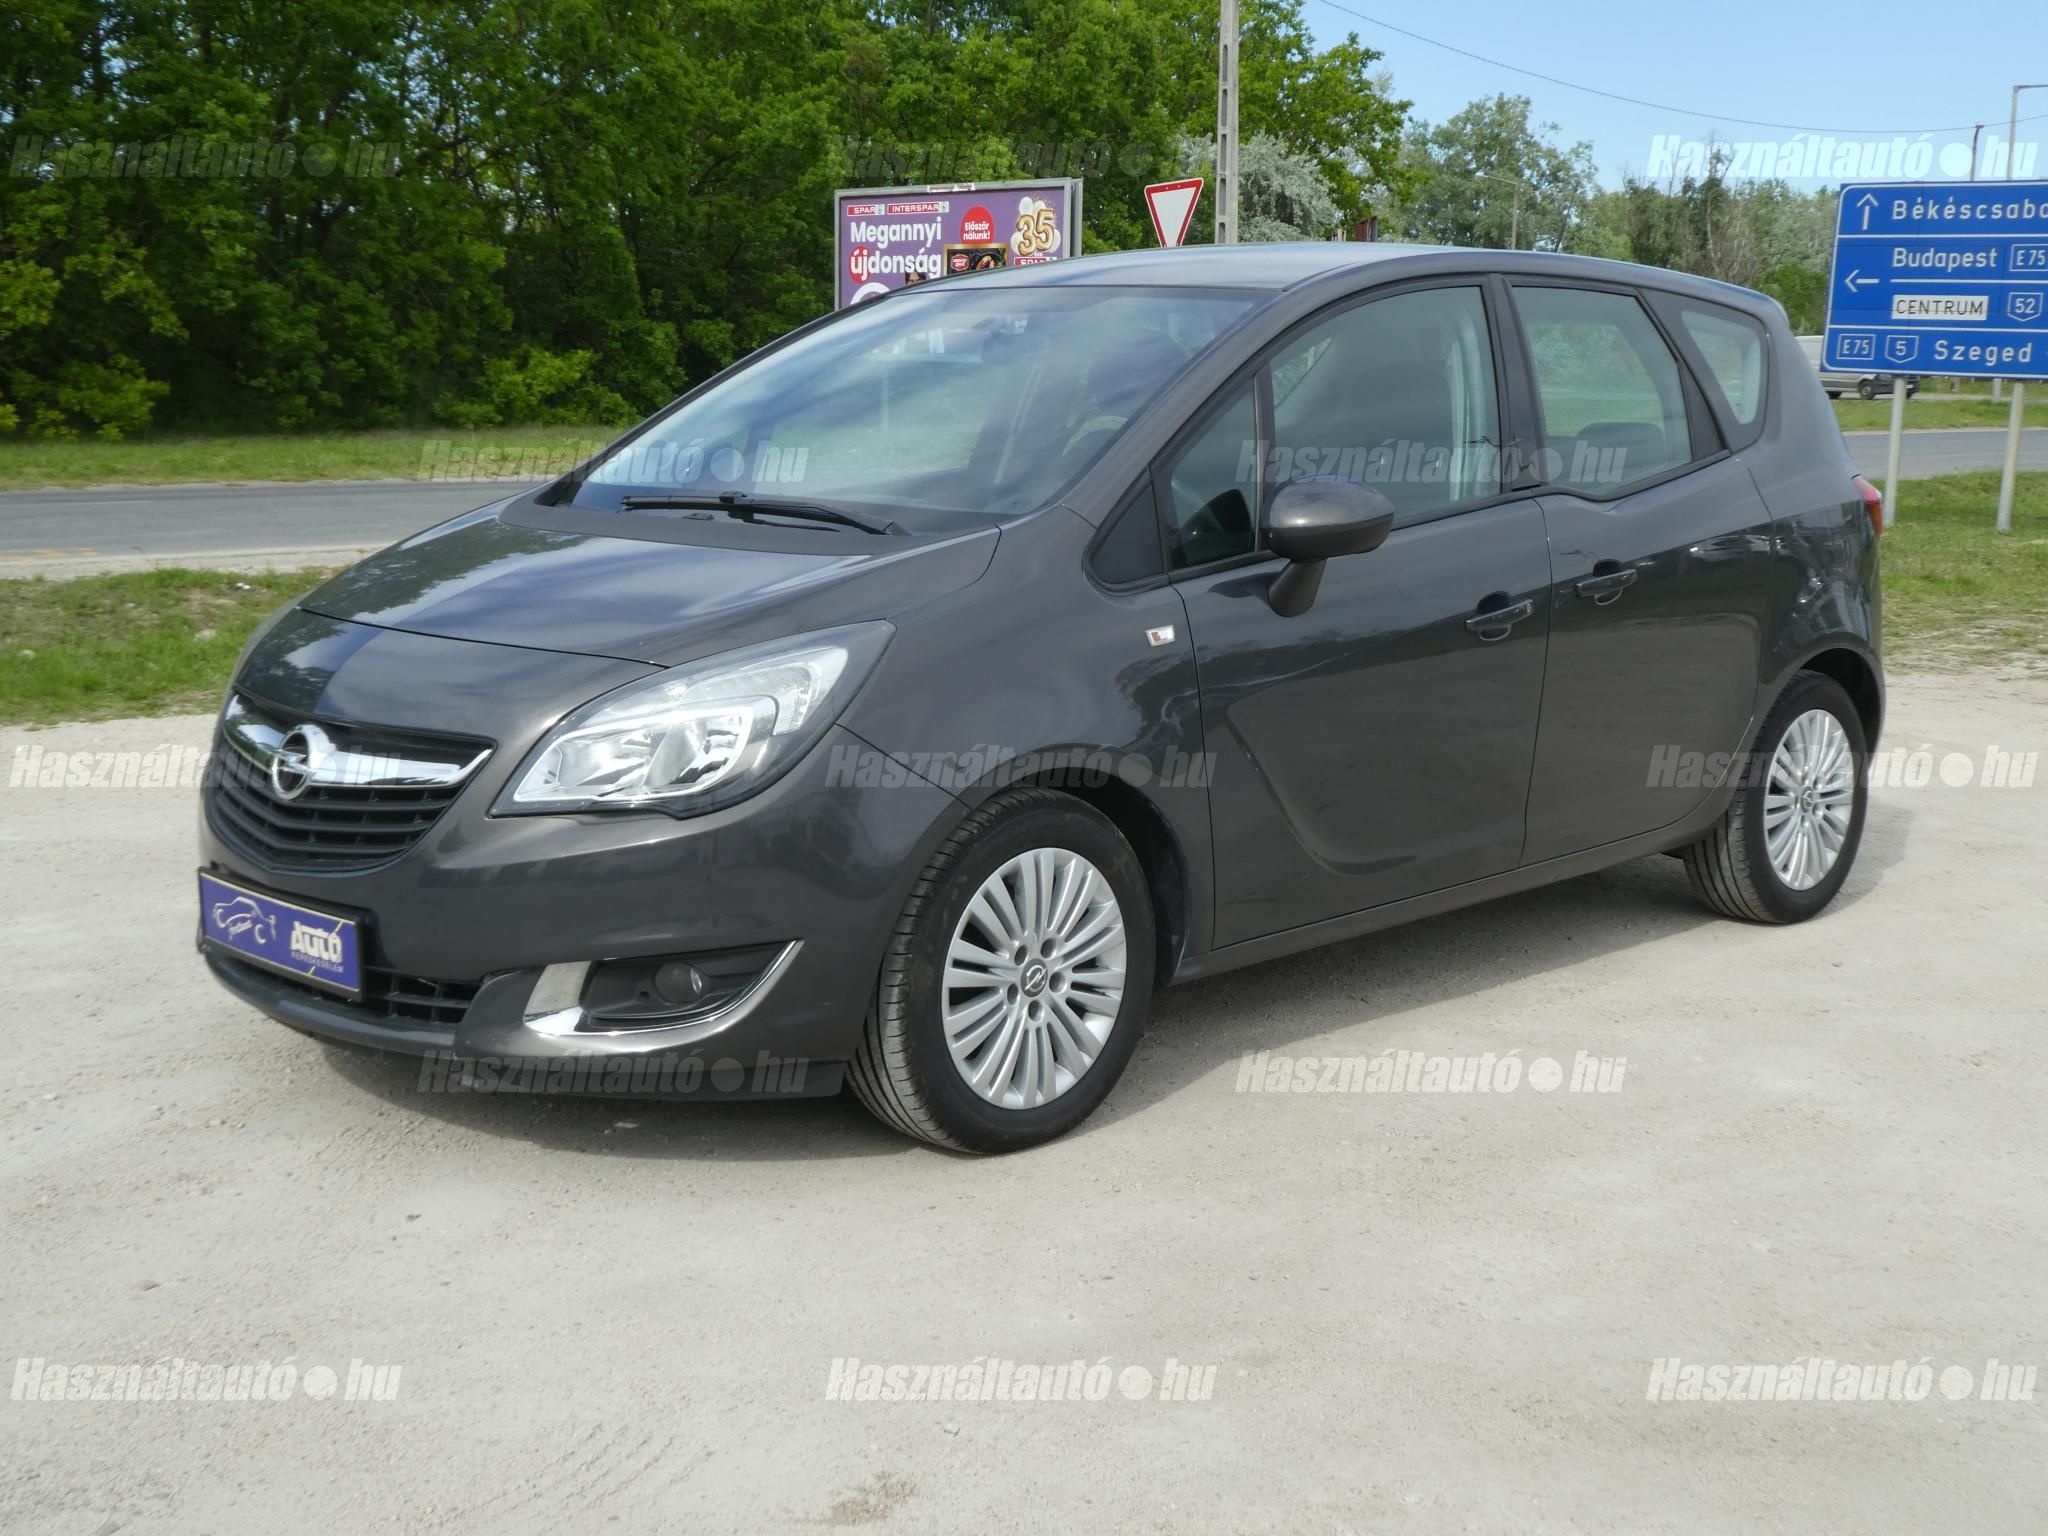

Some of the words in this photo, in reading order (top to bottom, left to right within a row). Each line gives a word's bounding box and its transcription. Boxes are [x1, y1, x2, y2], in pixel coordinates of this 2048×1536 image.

[853, 206, 876, 214] SPAR
[892, 203, 939, 213] INTERSPAR
[850, 216, 941, 249] Megannyi
[963, 230, 990, 240] nálunk!
[964, 221, 989, 231] Először
[1014, 208, 1056, 256] 35
[850, 246, 941, 281] újdonság
[1891, 247, 1998, 273] Budapest
[1895, 299, 1984, 316] CENTRUM
[2015, 298, 2036, 314] 52
[1895, 340, 1907, 356] 5
[1934, 340, 2033, 367] Szeged
